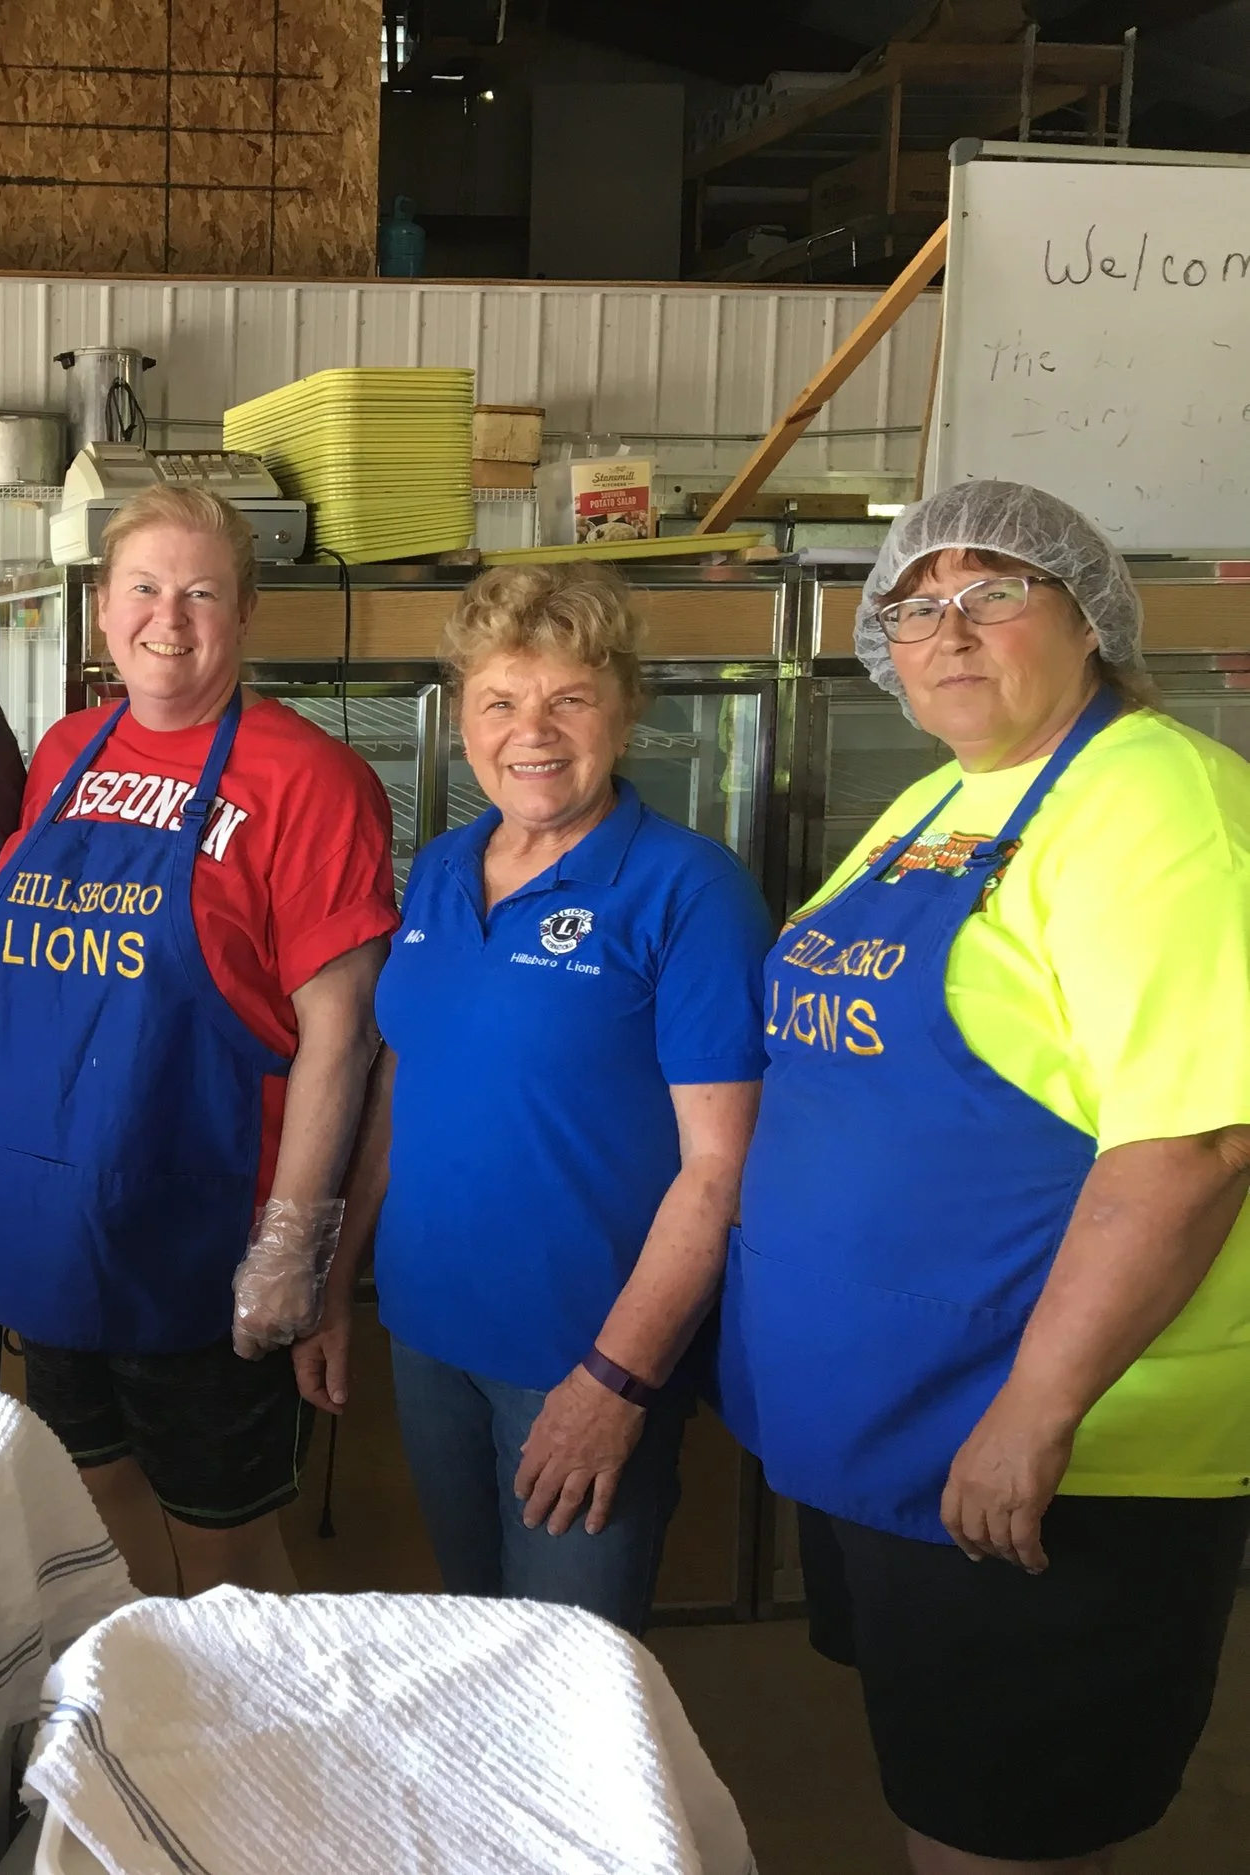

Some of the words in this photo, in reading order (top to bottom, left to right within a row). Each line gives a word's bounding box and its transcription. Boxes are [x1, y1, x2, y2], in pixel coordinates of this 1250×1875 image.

[590, 499, 615, 509] POTATO
[617, 496, 637, 506] SALAD
[7, 871, 163, 916] HILLSBORO
[403, 929, 425, 943] Mo
[556, 918, 574, 936] L
[2, 919, 145, 979] LIONS
[510, 952, 558, 968] Hillsboro
[566, 959, 601, 976] Lions
[766, 980, 884, 1056] LIONS
